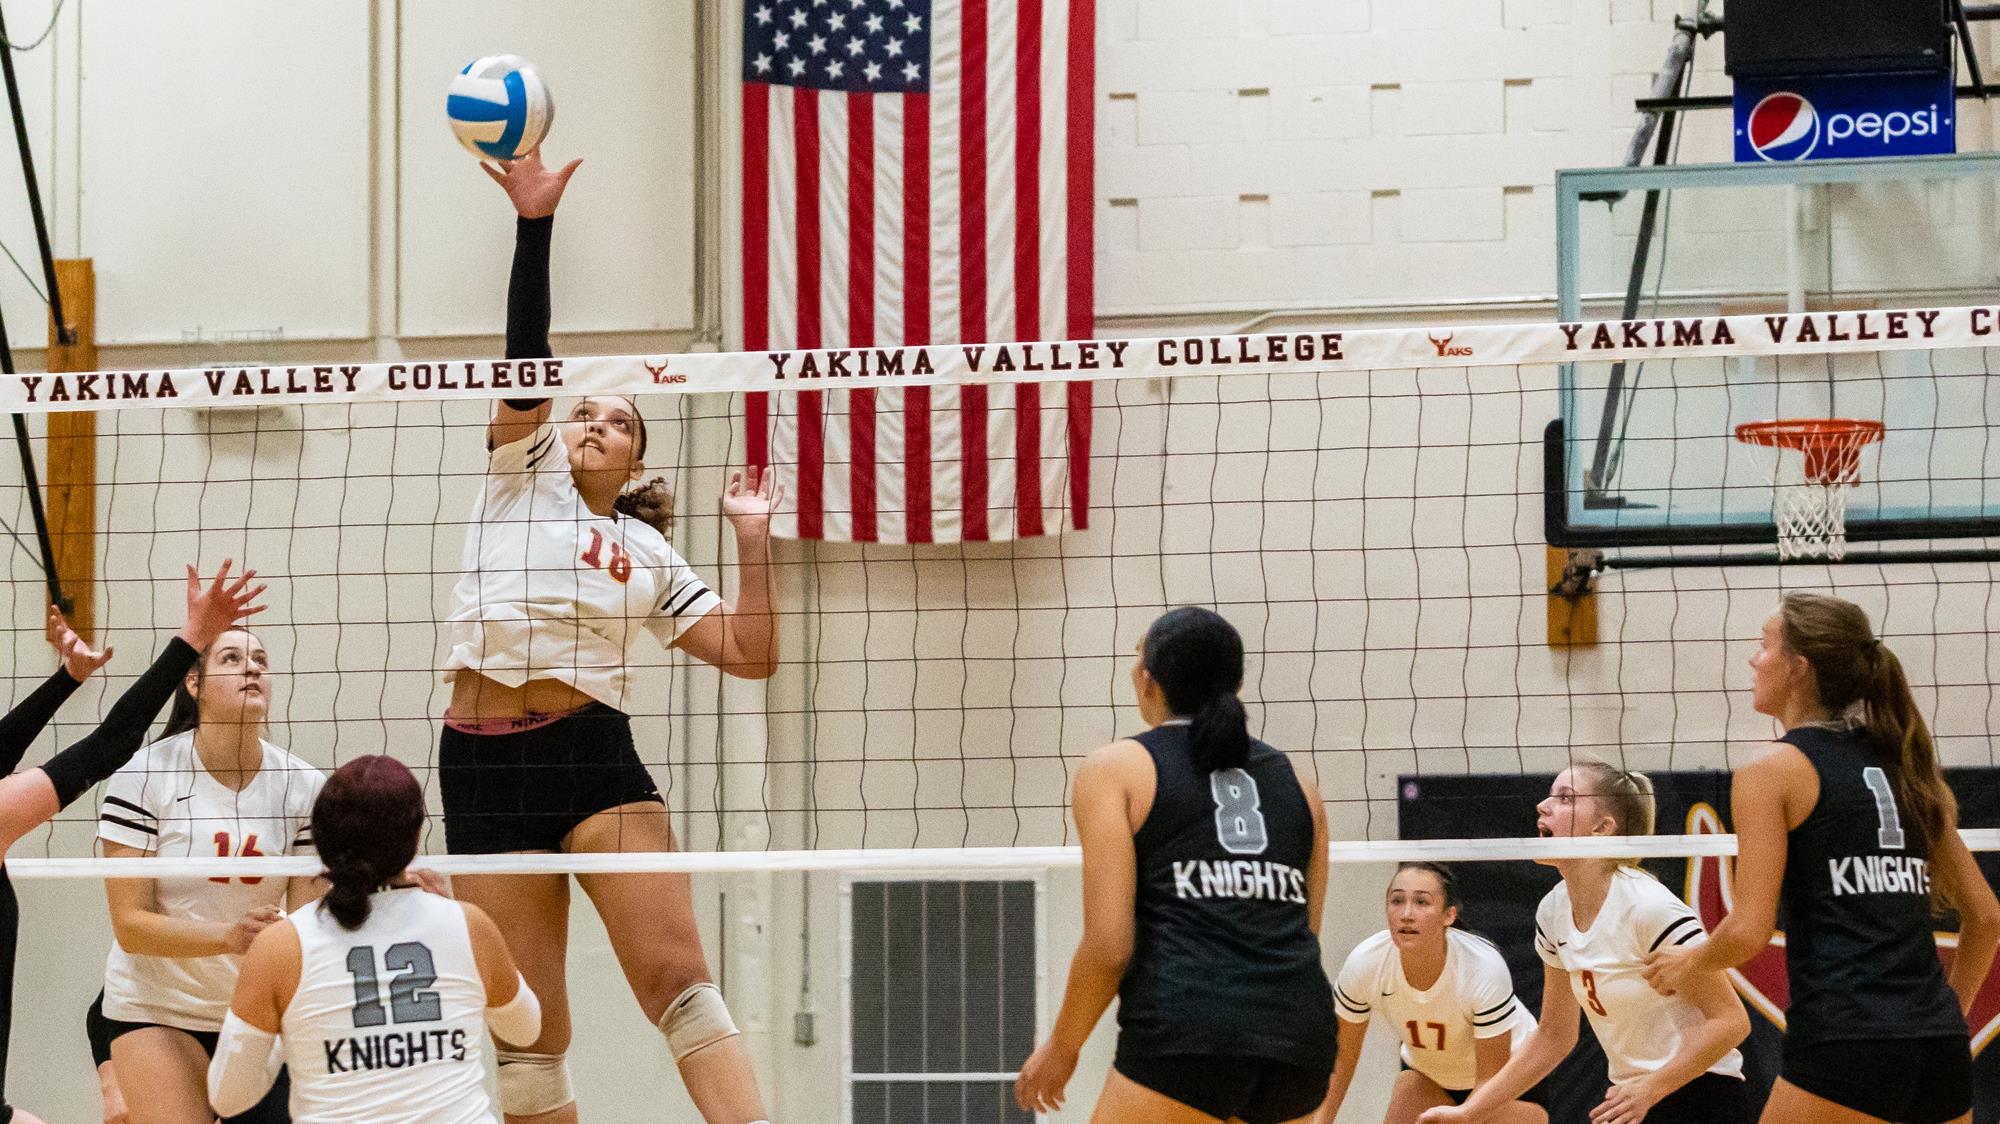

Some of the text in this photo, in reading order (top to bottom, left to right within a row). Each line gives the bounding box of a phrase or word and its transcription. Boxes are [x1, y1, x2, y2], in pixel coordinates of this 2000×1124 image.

[1827, 104, 1937, 145] pepsi
[1428, 331, 1473, 357] YAKS
[1559, 308, 2000, 351] YAKIMA VALLEY C
[644, 359, 687, 384] YAKS
[768, 333, 1344, 380] YAKIMA VALLEY COLLEGE
[21, 360, 563, 402] YAKIMA VALLEY COLLEGE
[1210, 767, 1268, 855] 8
[1862, 766, 1905, 849] 1
[208, 831, 264, 885] 16
[1172, 859, 1307, 904] KNIGHTS
[346, 941, 442, 1028] 12
[1582, 969, 1607, 1017] 3
[324, 1028, 466, 1074] KNIGHTS
[1406, 1020, 1446, 1051] 17
